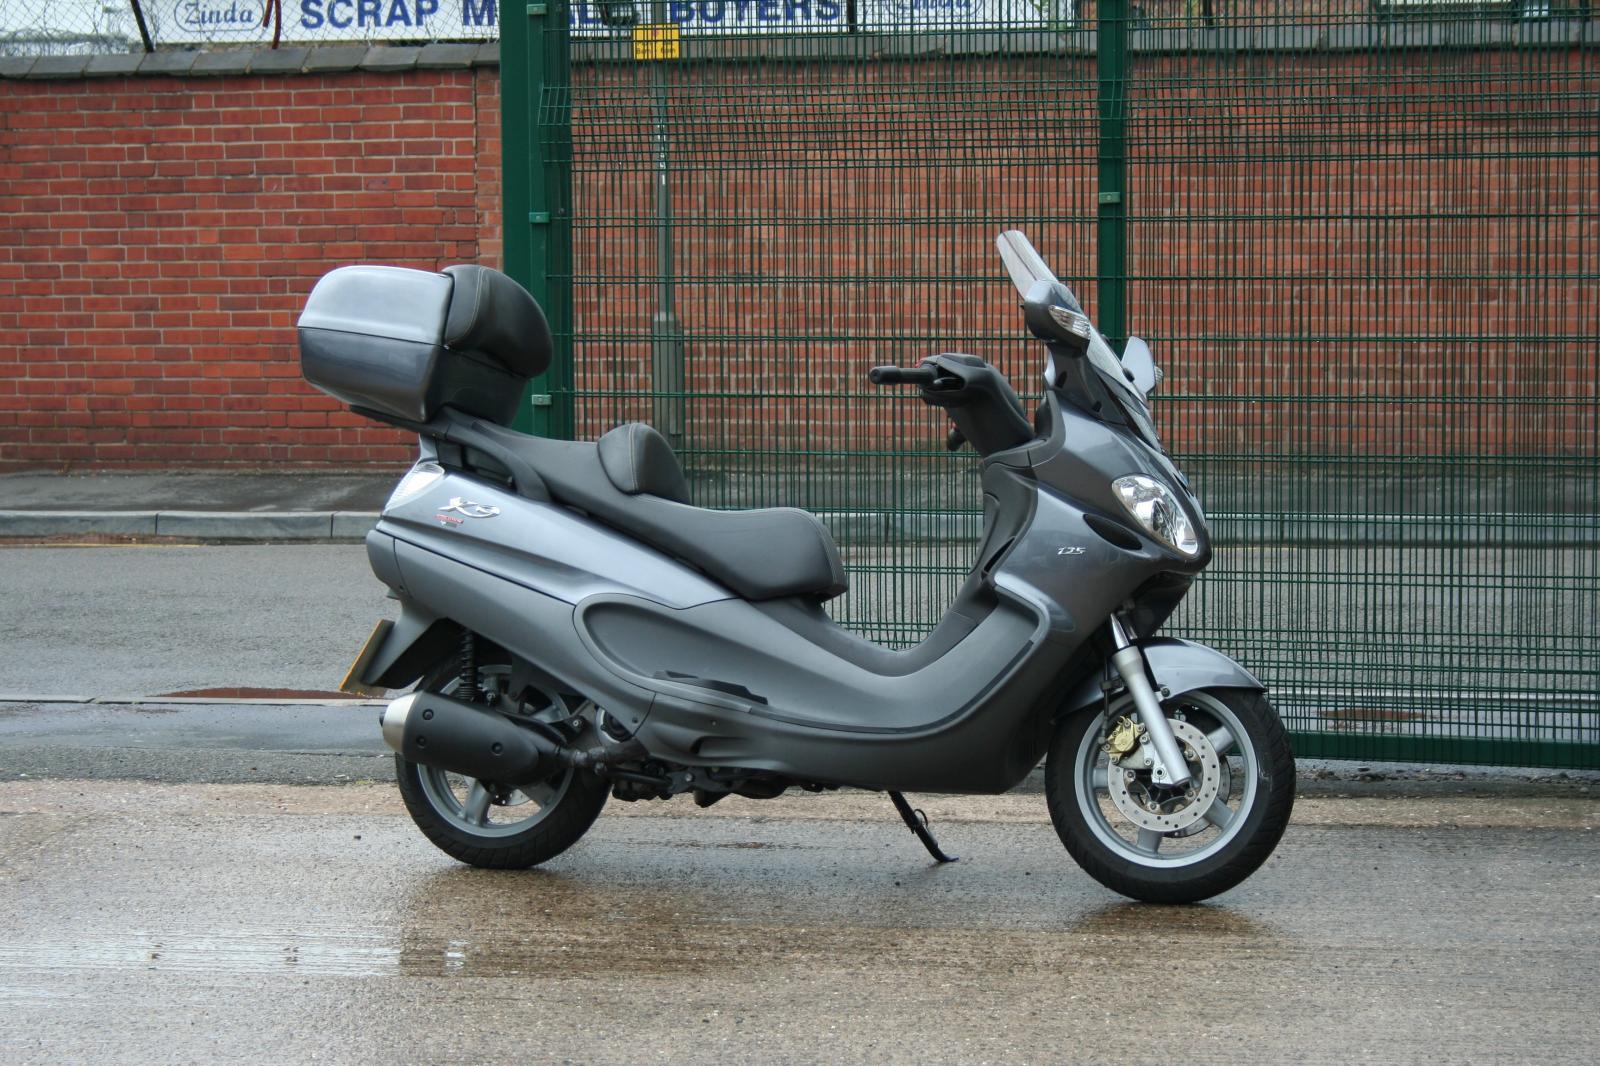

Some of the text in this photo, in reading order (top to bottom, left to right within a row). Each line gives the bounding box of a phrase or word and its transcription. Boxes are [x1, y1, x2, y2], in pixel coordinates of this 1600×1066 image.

[184, 0, 255, 24] Zinda
[300, 0, 439, 29] SCRAP
[670, 0, 840, 23] BUYERS
